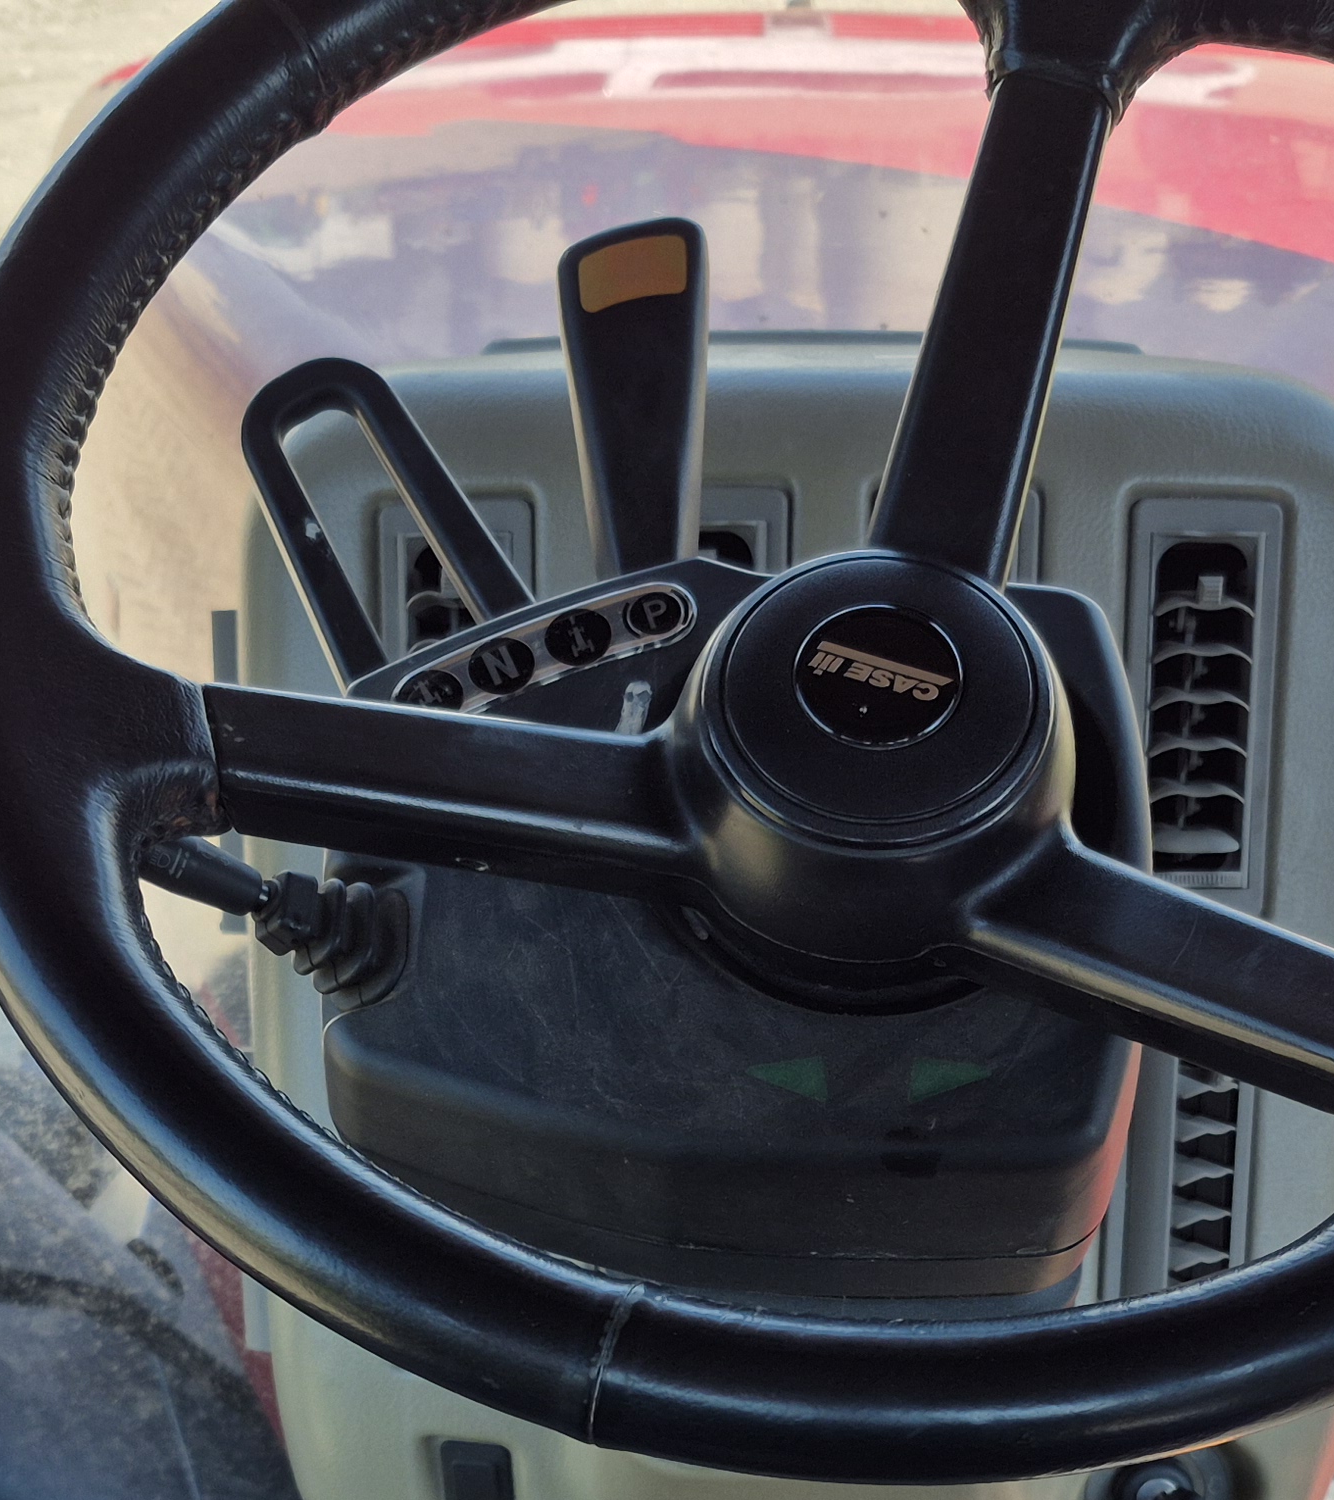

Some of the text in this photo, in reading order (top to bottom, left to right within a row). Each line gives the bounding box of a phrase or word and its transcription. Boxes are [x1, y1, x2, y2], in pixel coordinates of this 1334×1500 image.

[641, 599, 668, 630] P
[479, 644, 521, 687] N
[842, 661, 940, 702] CASE
